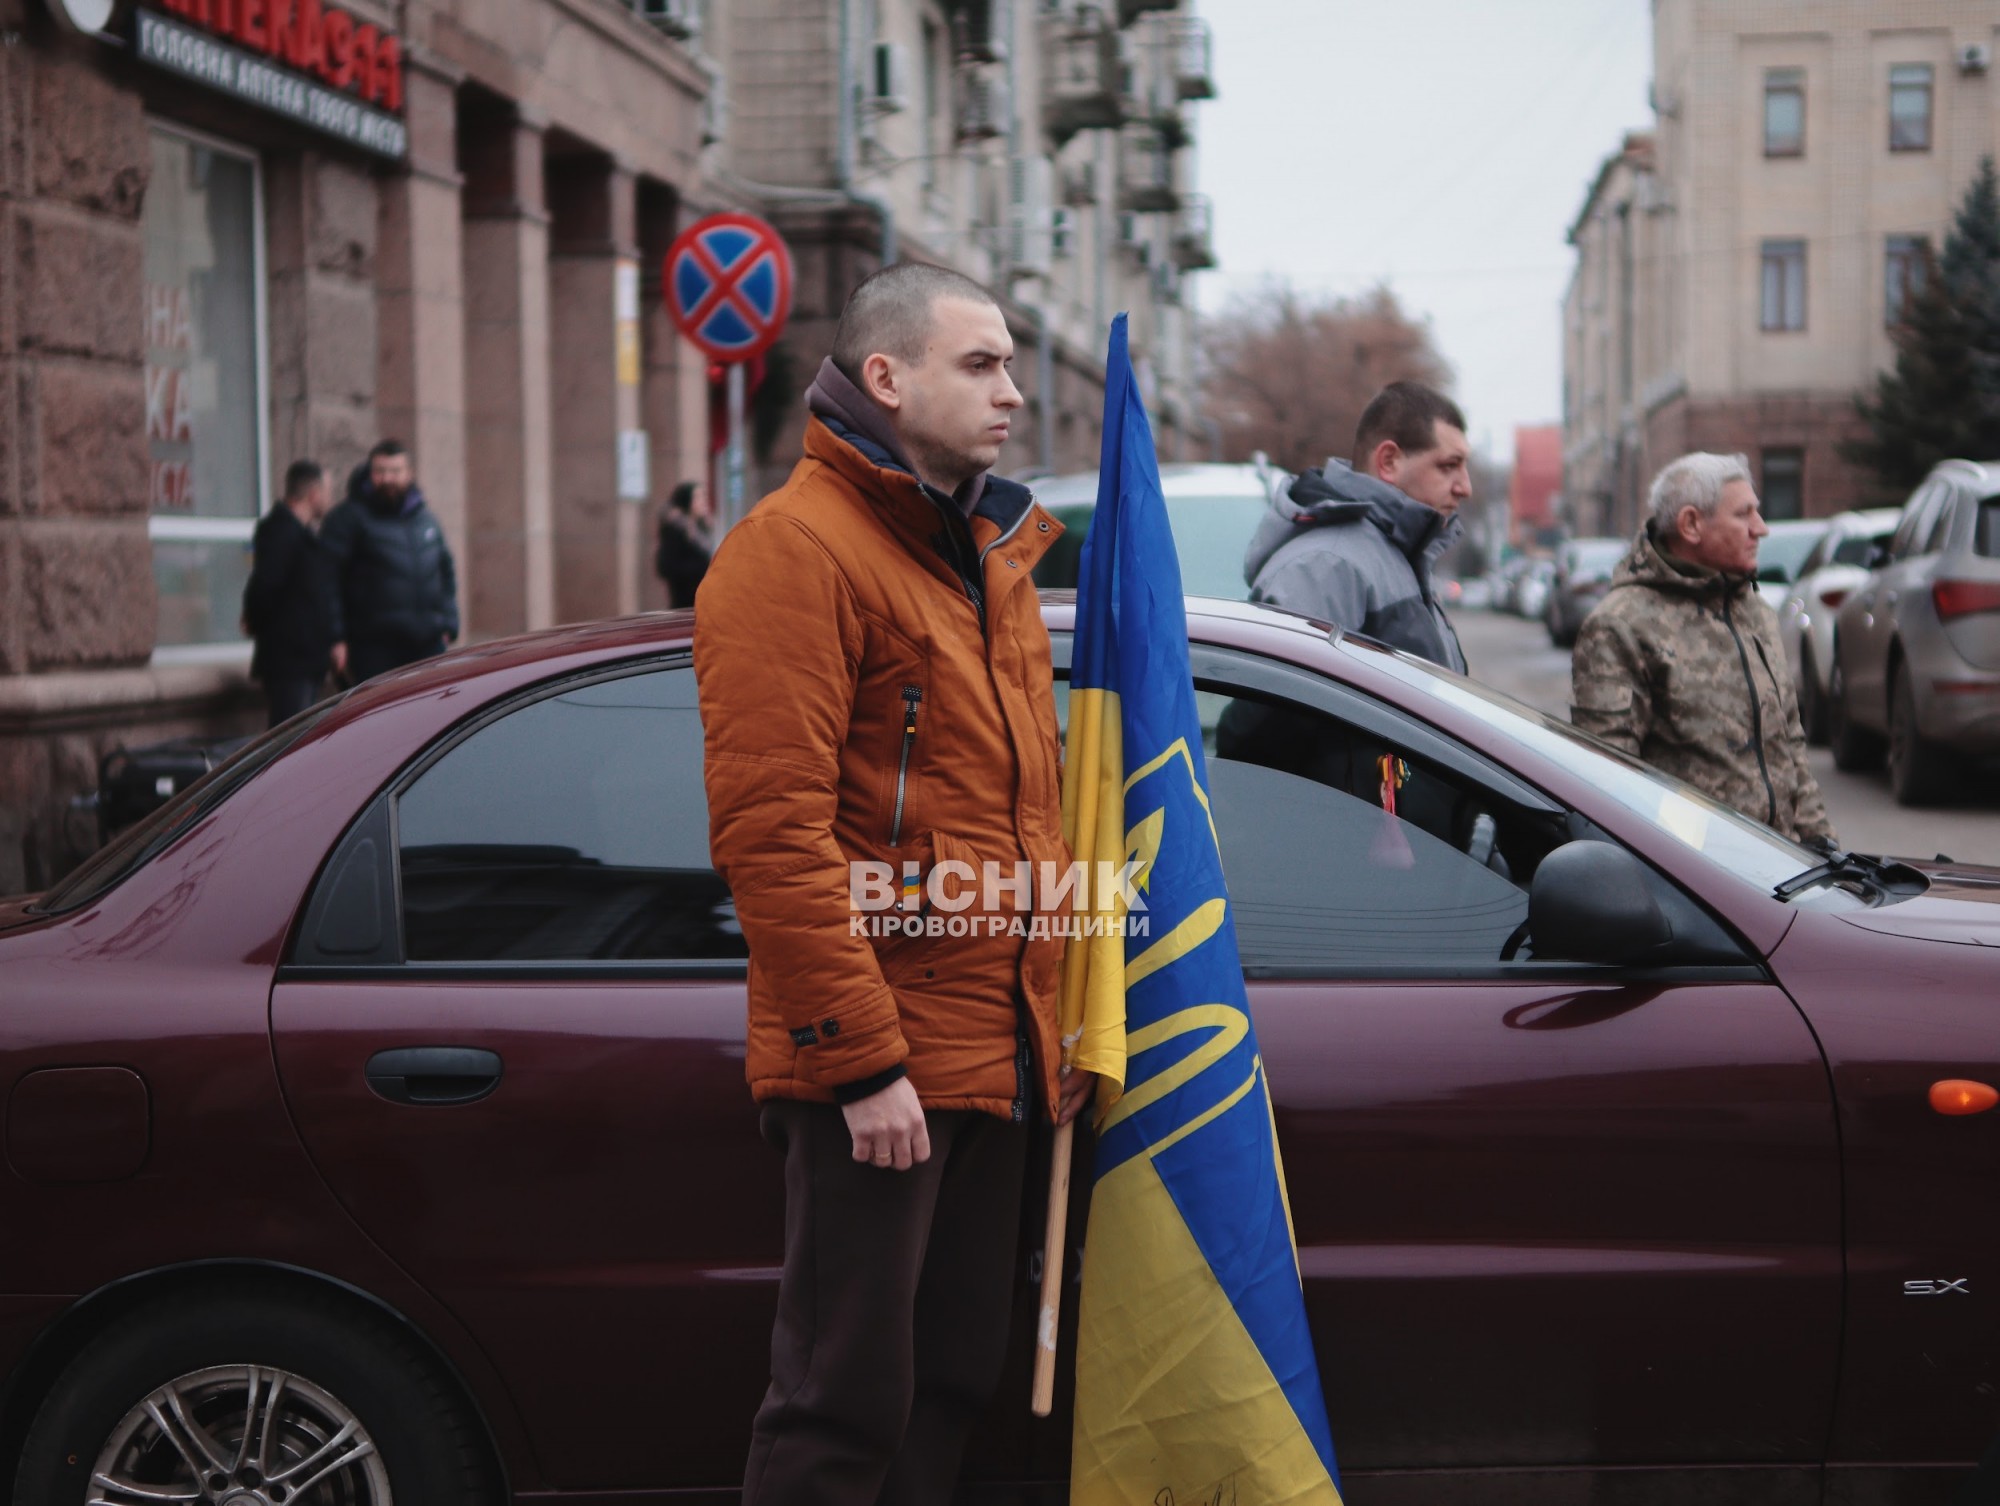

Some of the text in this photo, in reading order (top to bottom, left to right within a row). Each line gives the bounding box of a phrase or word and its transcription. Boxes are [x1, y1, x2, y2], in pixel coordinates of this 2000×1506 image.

[141, 18, 234, 89] ГОЛОВНА
[237, 59, 304, 117] АПТЕКА
[1904, 1278, 1970, 1295] SX
